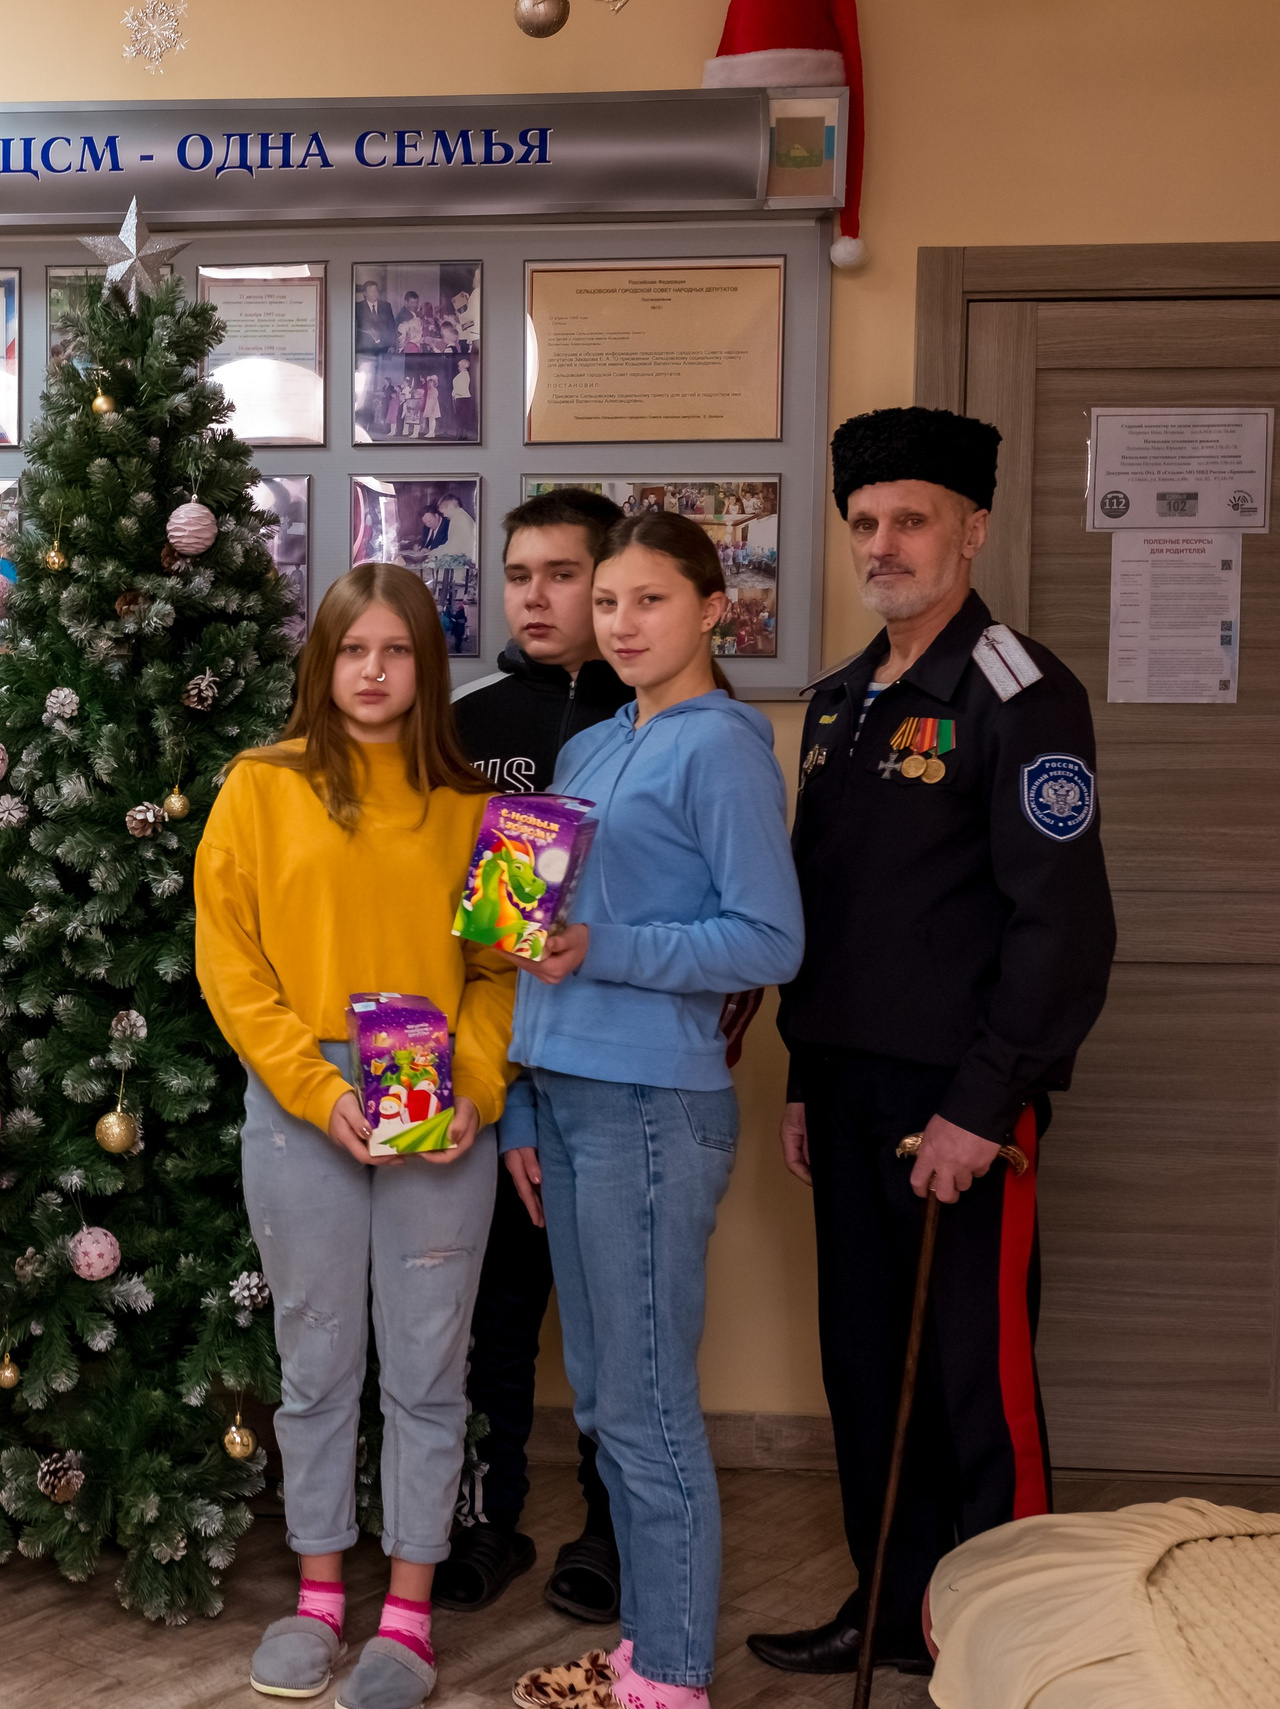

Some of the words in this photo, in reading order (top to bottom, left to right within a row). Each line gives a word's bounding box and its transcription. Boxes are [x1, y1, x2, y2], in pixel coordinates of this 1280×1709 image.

[139, 154, 154, 162] -
[176, 131, 335, 180] ОДНА
[354, 127, 554, 169] СЕМЬЯ
[1104, 499, 1126, 509] 112
[1166, 500, 1187, 512] 102
[1165, 547, 1206, 555] РОДИТЕЛЕЙ
[1044, 762, 1079, 772] РОССИЯ
[1048, 770, 1074, 778] РЕЕСТР
